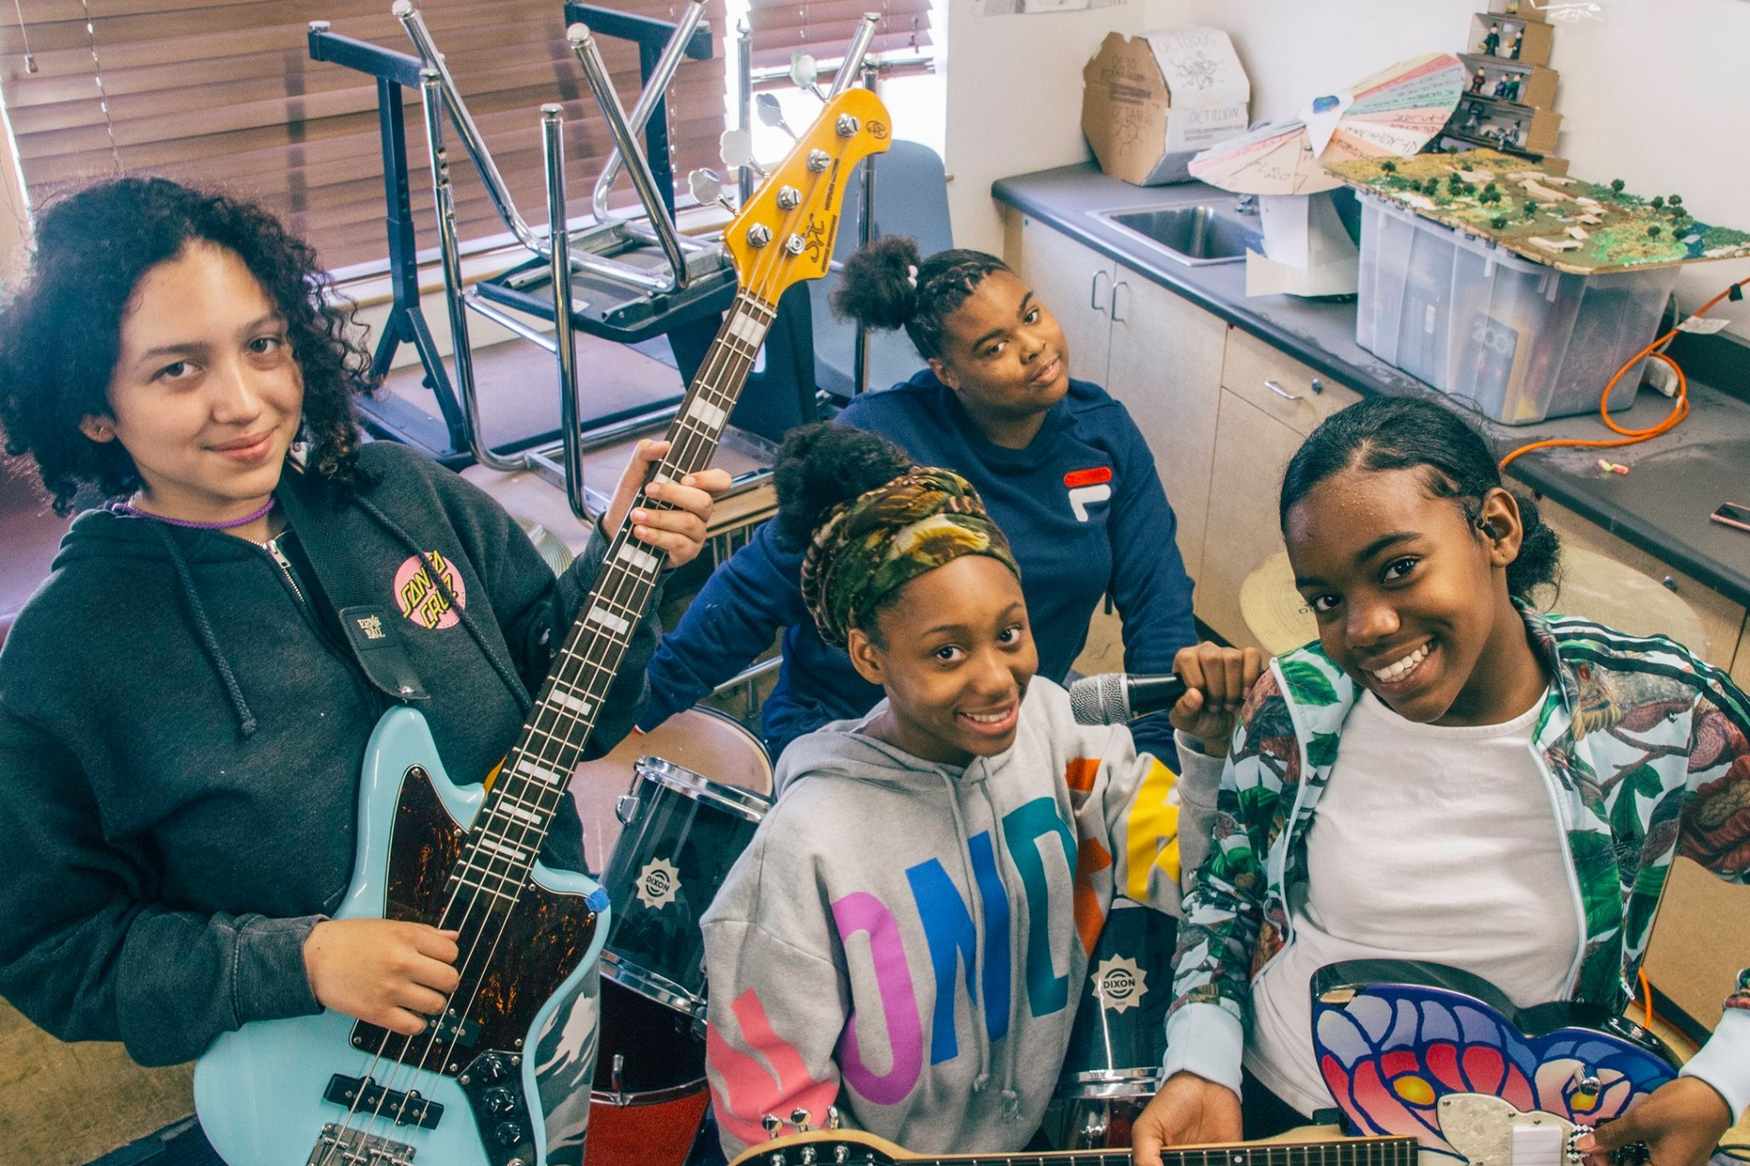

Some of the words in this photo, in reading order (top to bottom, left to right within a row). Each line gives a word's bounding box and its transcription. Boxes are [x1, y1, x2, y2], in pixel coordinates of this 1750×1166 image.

[401, 550, 447, 619] SANA
[646, 875, 670, 891] DIXON
[1104, 979, 1135, 989] DIXON
